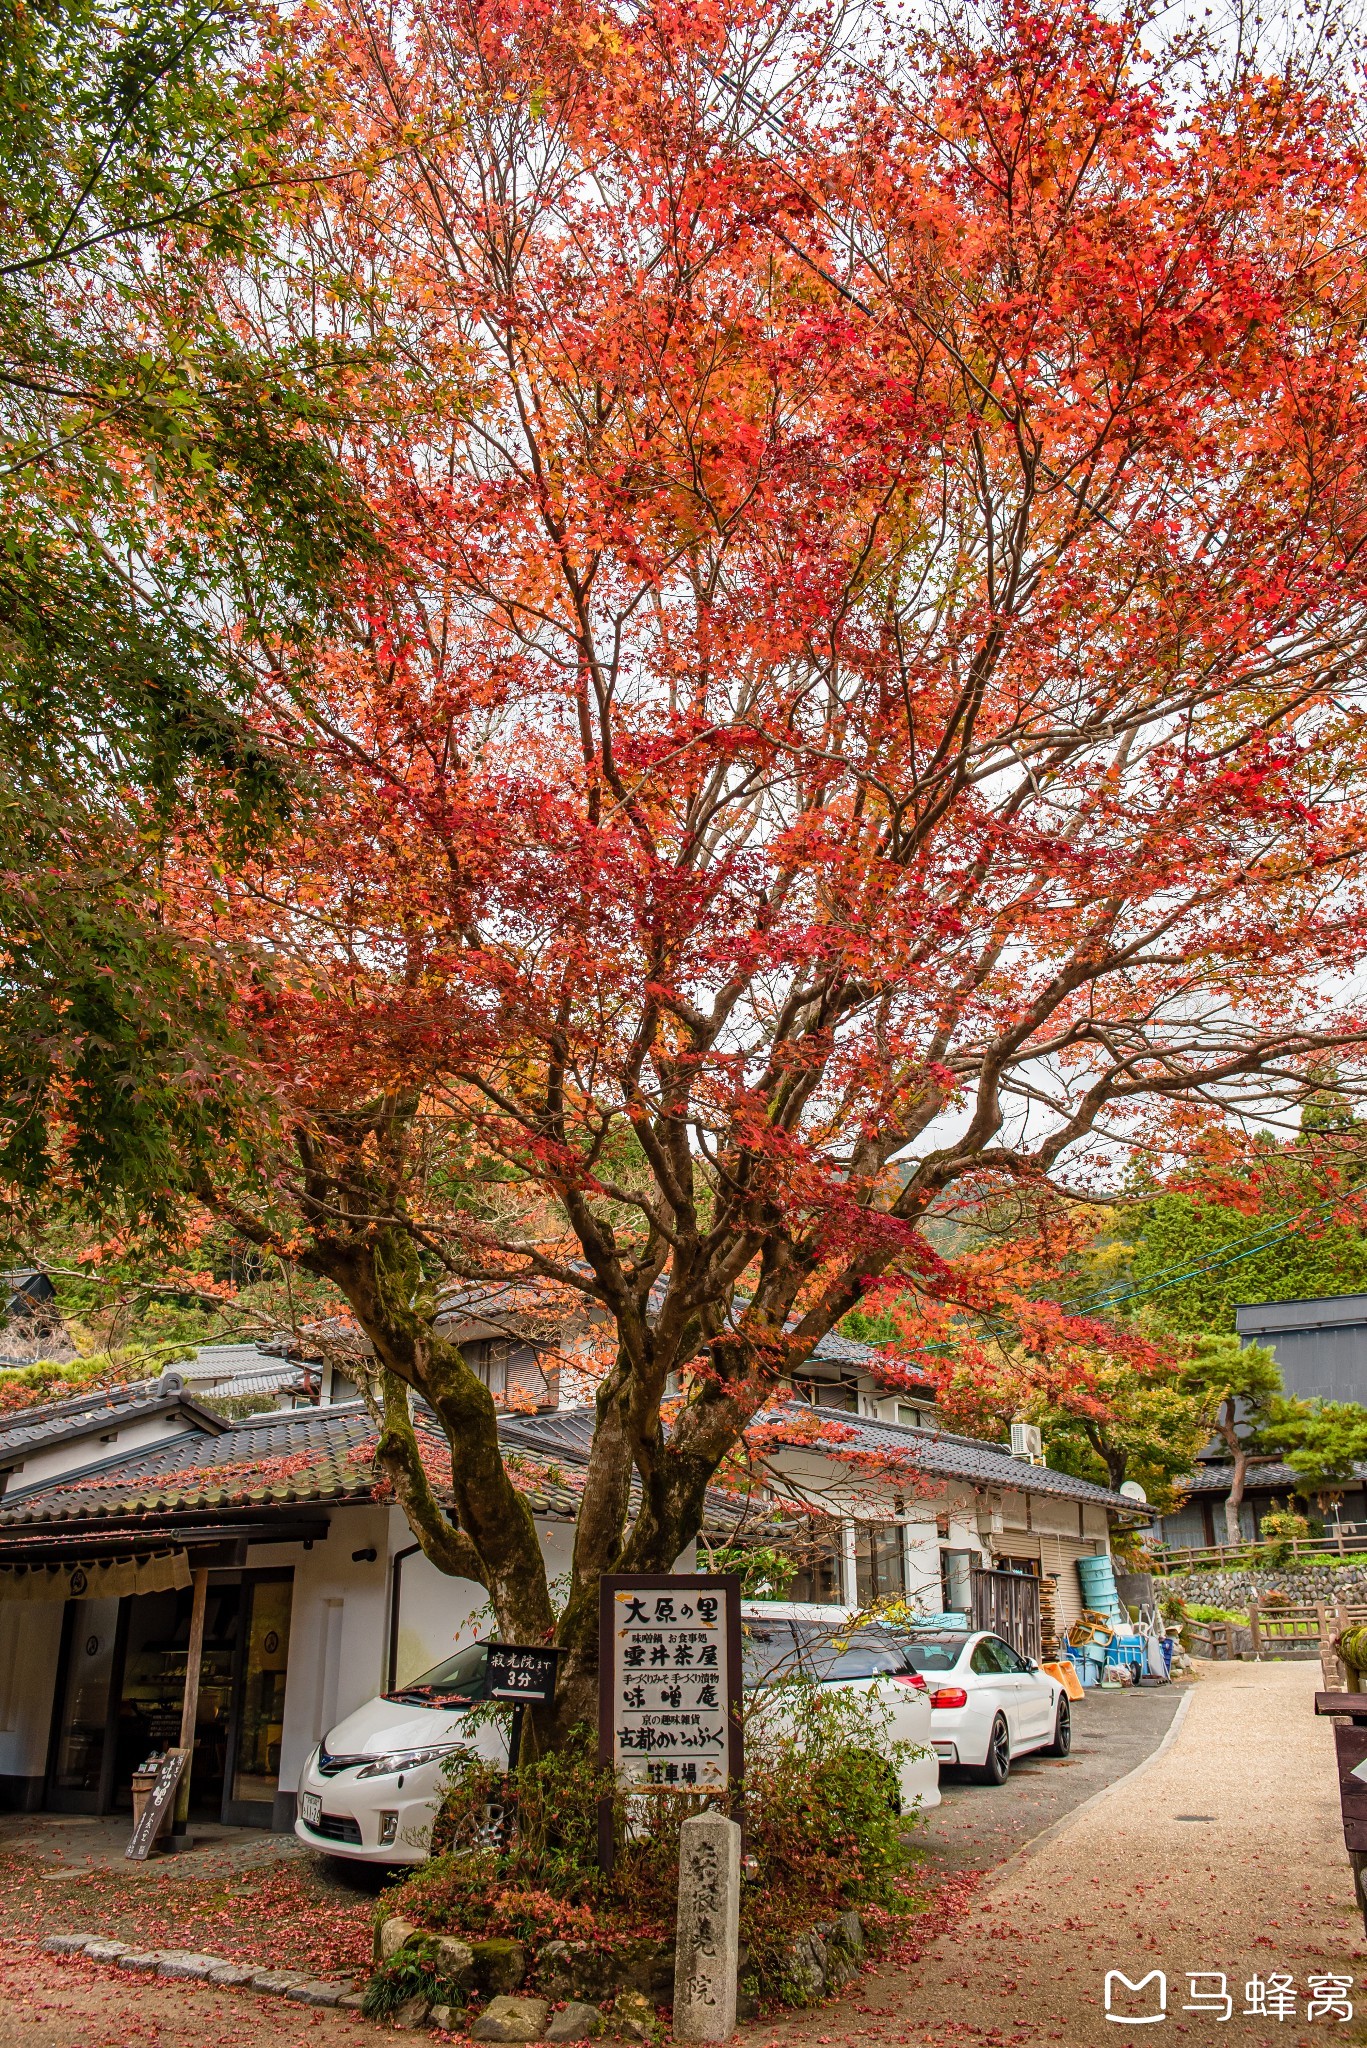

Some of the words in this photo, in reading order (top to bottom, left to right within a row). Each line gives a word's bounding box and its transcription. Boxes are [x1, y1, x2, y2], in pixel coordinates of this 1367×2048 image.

[624, 1597, 718, 1623] 大原の里
[632, 1633, 663, 1644] 味噌鍋
[668, 1633, 707, 1644] お食事処
[624, 1644, 718, 1667] 雲井茶屋
[507, 1671, 531, 1687] 3分
[623, 1673, 669, 1685] 手づくりみそ
[671, 1673, 719, 1685] 手づくり漬物
[623, 1685, 719, 1708] 味噌庵
[641, 1714, 701, 1725] 京の趣味雑貨
[617, 1726, 724, 1750] 古都のいっぷく
[647, 1763, 697, 1785] 駐車場
